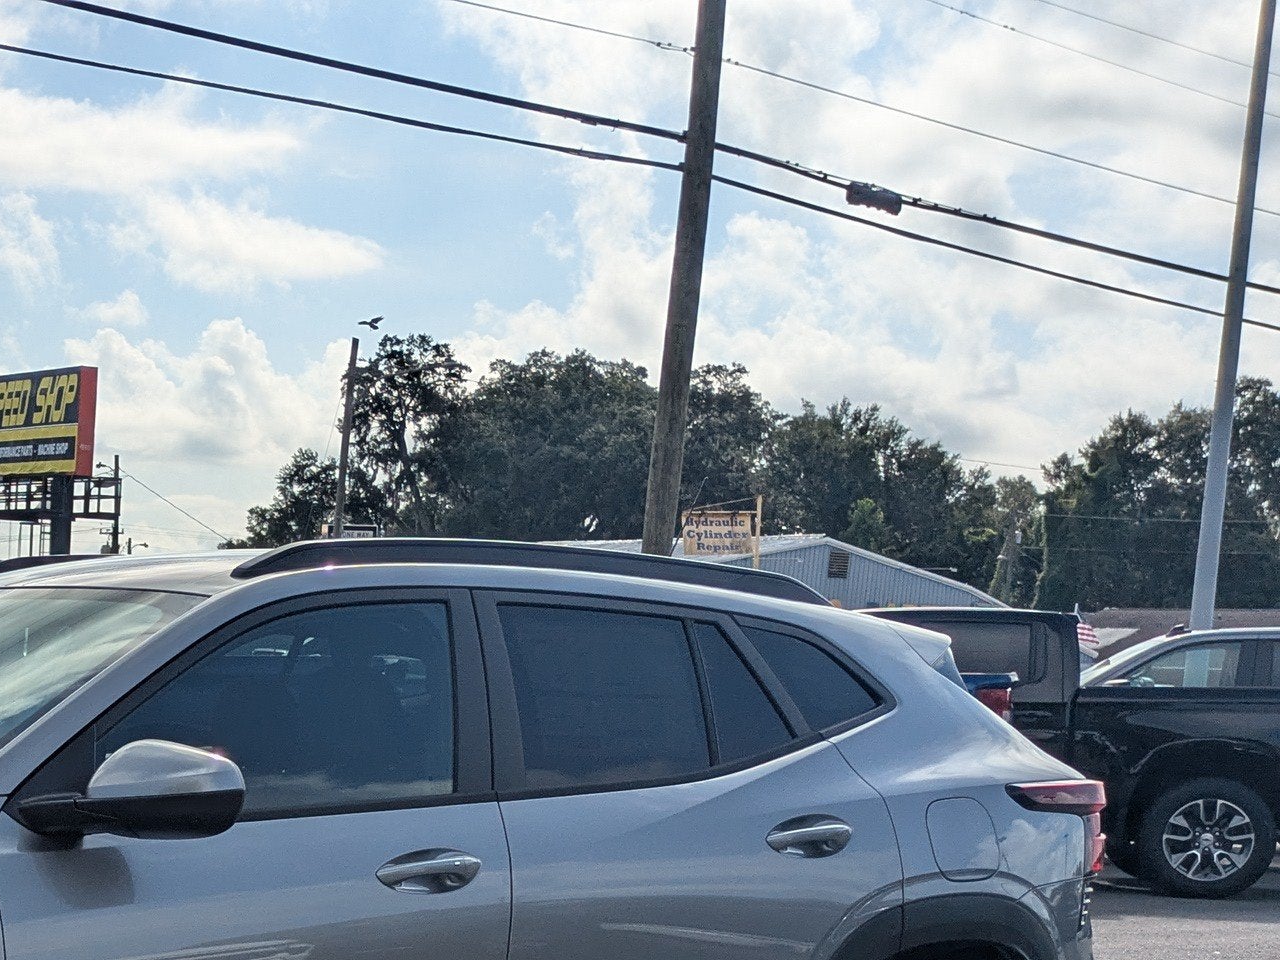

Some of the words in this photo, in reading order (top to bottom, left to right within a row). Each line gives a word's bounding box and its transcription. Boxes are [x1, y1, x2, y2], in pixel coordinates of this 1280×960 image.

[32, 373, 78, 424] SHOP
[684, 517, 745, 529] Hydraulic
[356, 531, 370, 539] WAY
[686, 530, 749, 541] Cylinder
[696, 542, 740, 553] Repair
